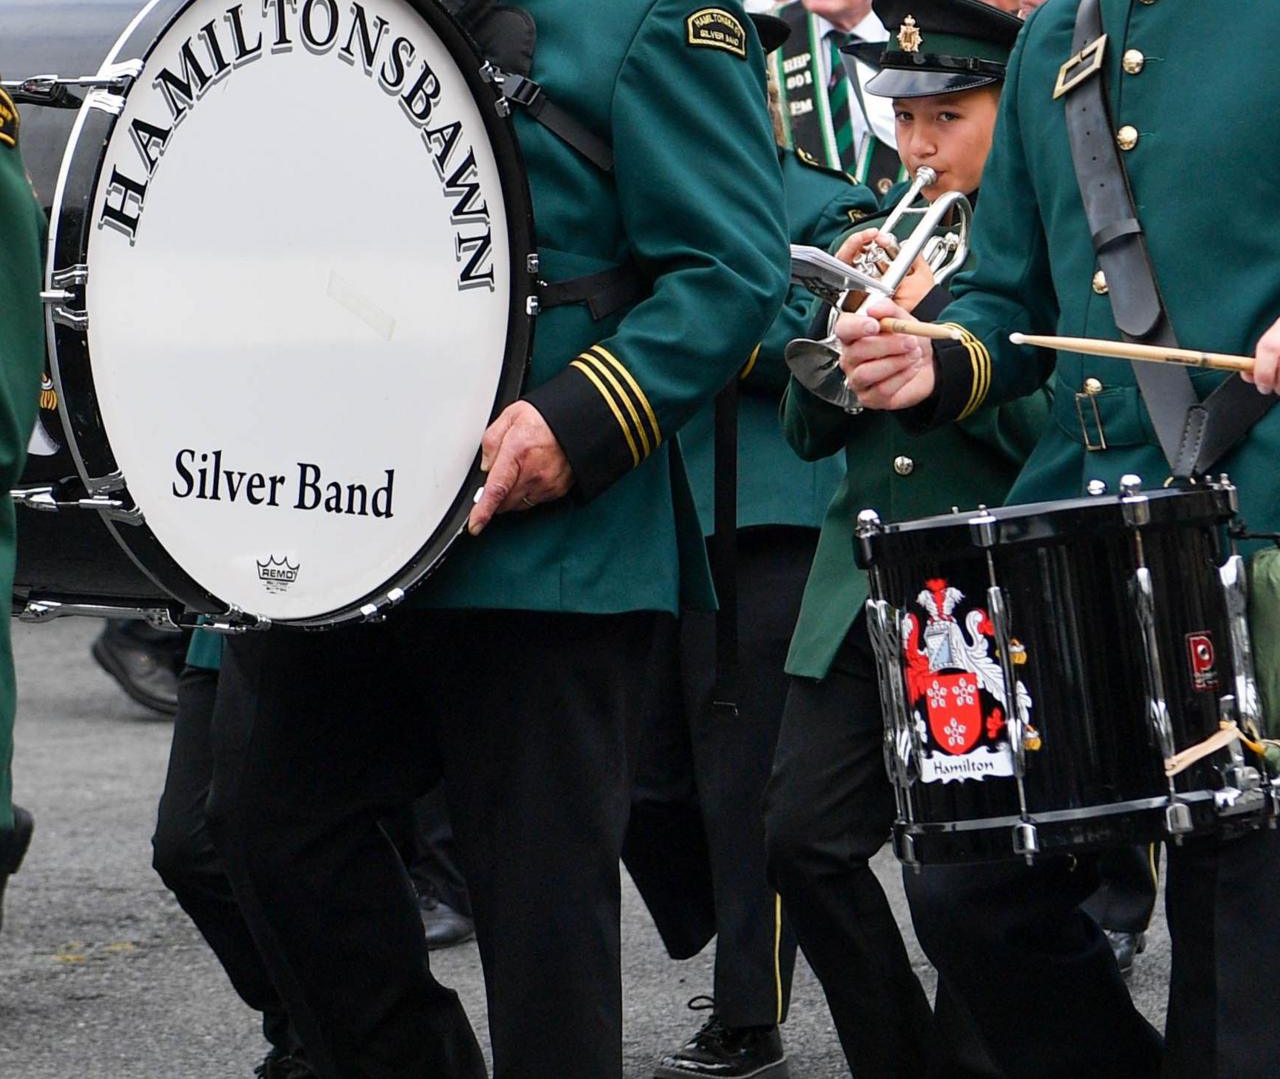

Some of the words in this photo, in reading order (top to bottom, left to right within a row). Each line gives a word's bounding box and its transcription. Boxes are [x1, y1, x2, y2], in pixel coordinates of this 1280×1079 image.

[173, 449, 285, 507] Silver
[294, 462, 395, 519] Band
[262, 568, 294, 579] REMO
[933, 758, 994, 775] Hamilton
